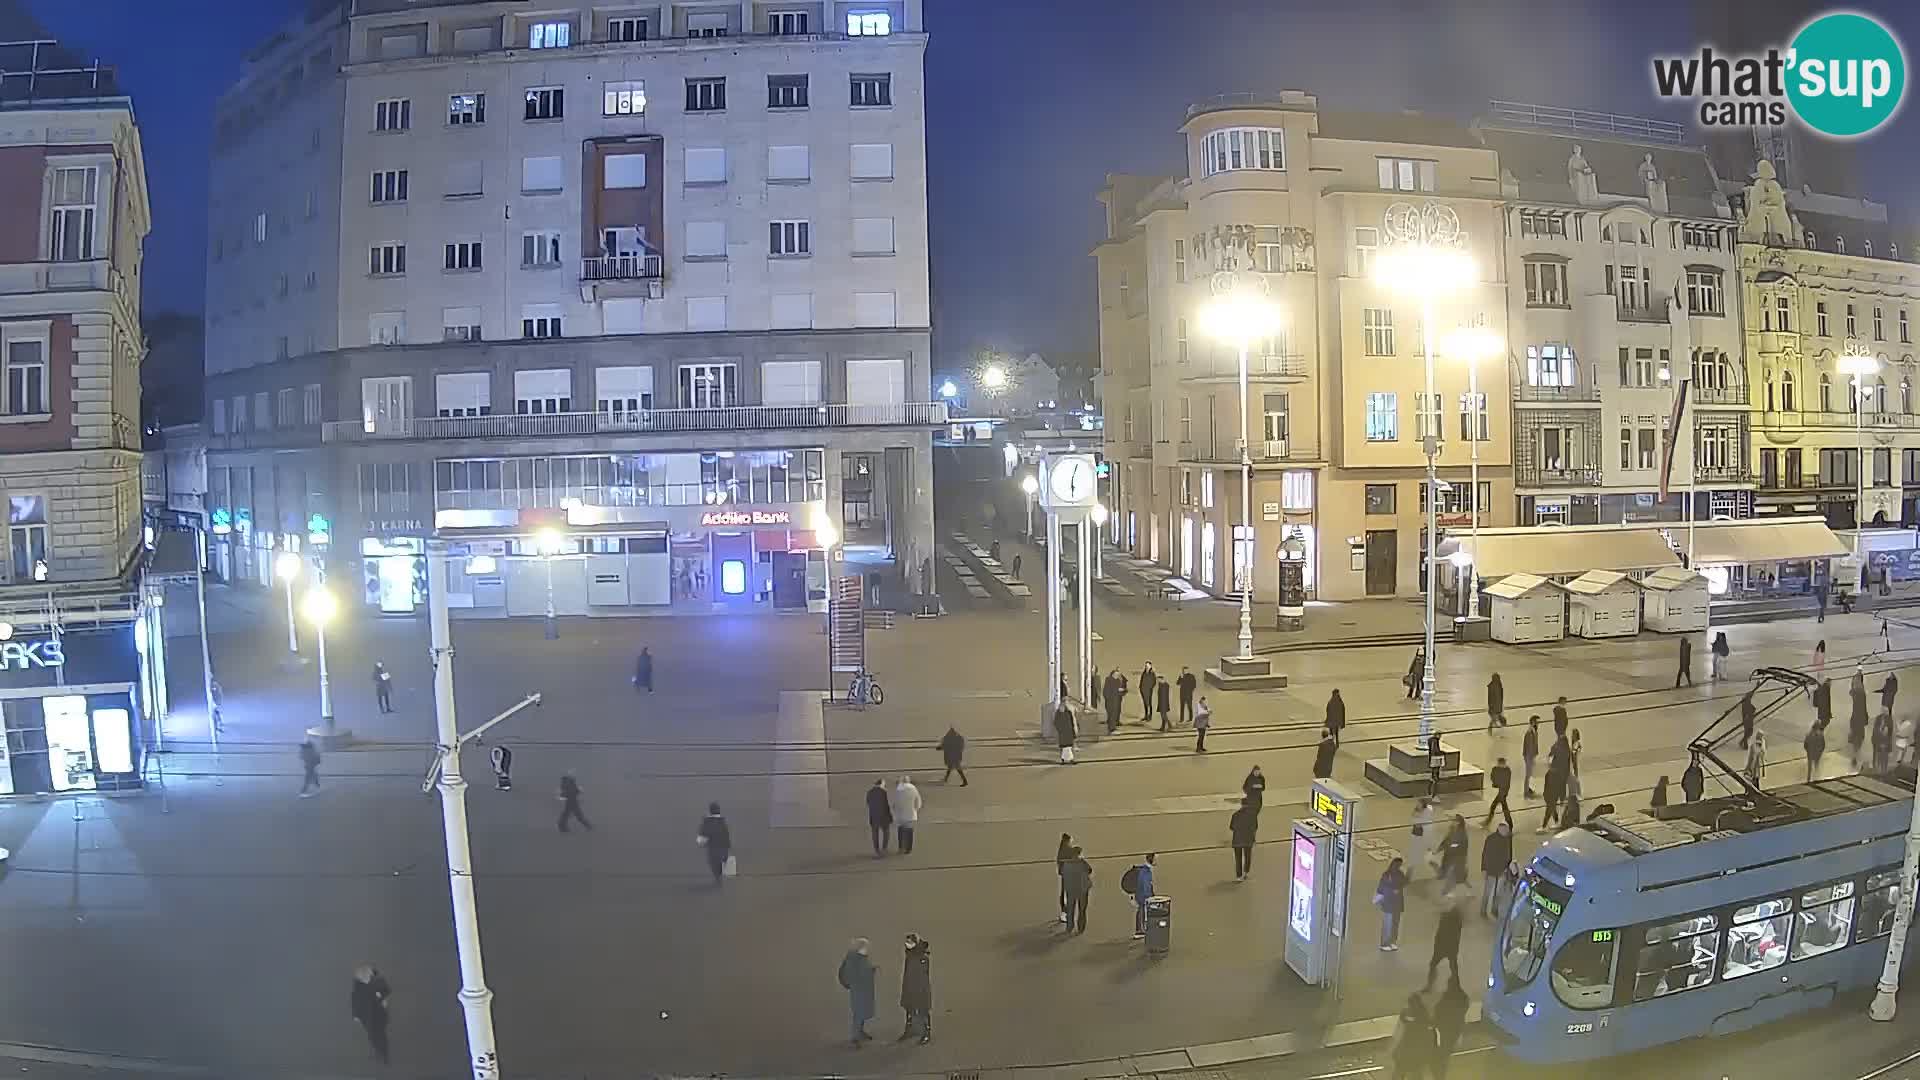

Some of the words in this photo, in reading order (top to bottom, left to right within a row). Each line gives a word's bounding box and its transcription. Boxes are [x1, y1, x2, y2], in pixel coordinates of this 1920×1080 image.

[702, 511, 751, 525] Addiko
[753, 511, 790, 524] Bank
[0, 640, 65, 669] AKS
